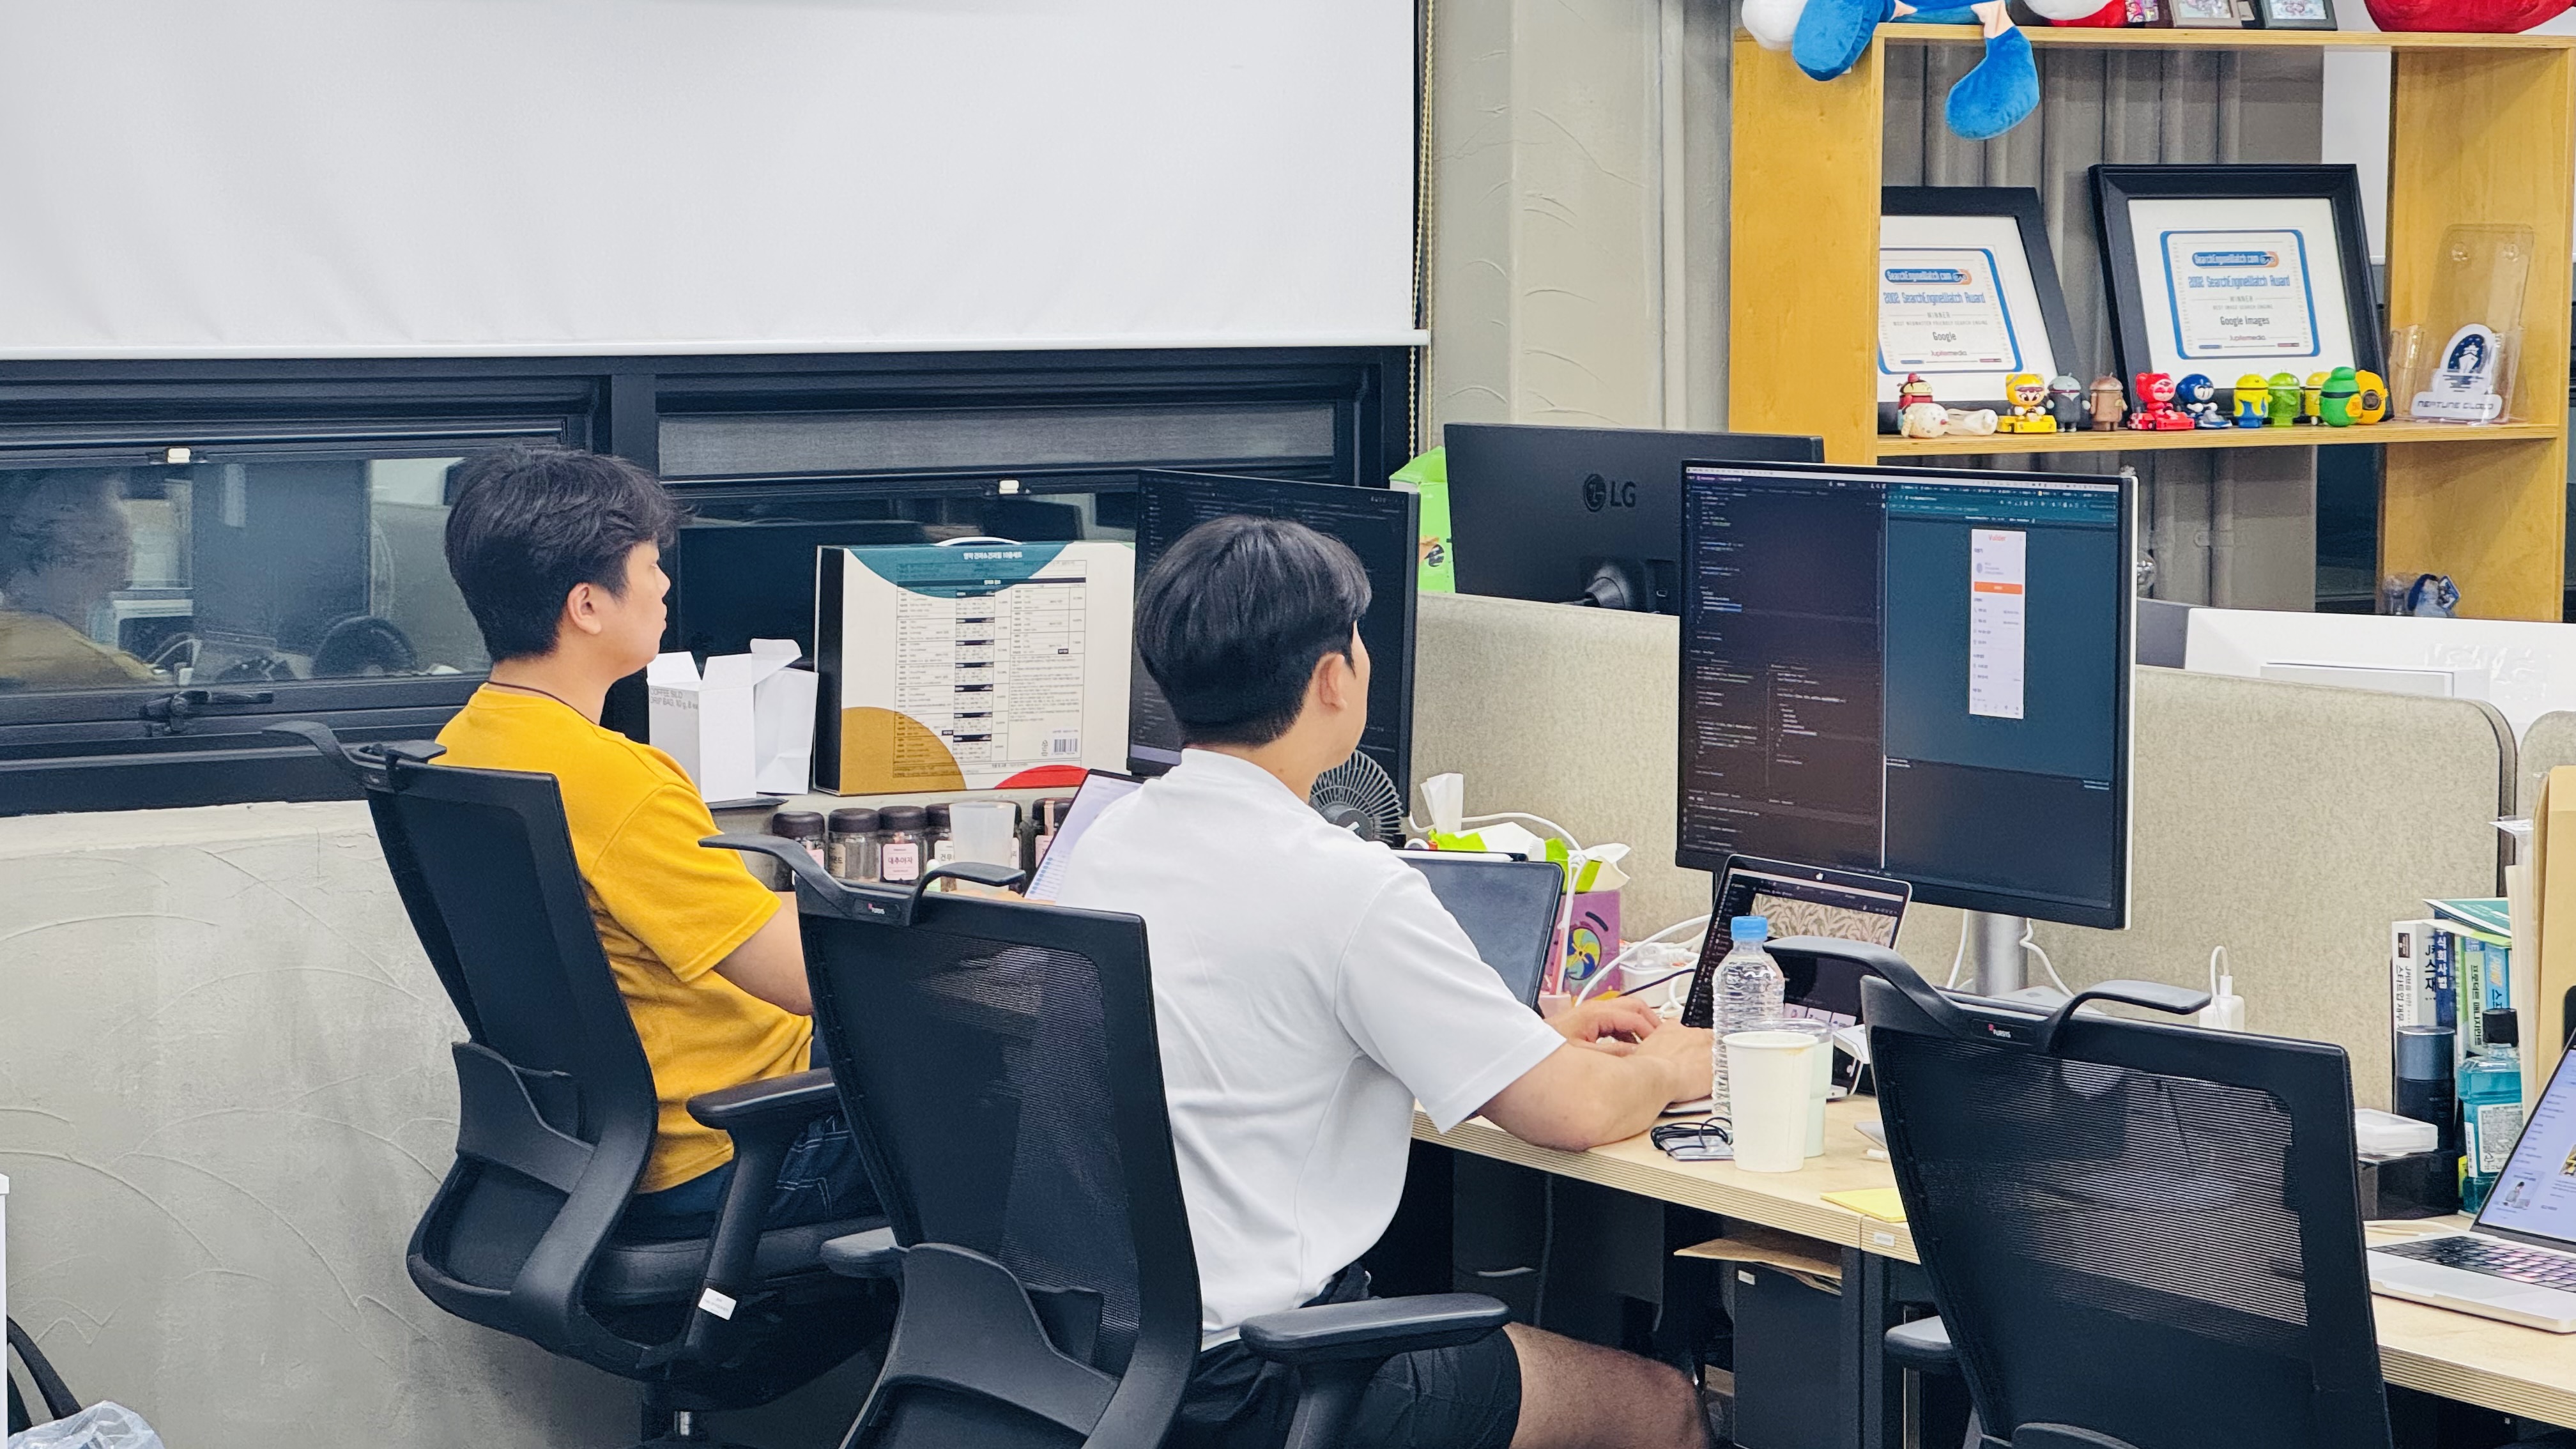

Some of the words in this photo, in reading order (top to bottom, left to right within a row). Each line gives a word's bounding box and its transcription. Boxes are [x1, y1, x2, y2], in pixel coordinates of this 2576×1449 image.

[2220, 316, 2243, 327] Google
[2245, 316, 2270, 326] Images
[1933, 332, 1957, 342] Google
[2418, 401, 2460, 409] NEPTUNE
[1610, 480, 1636, 508] LG
[650, 687, 670, 698] COFFEE
[887, 856, 913, 864] 대추야자
[940, 853, 955, 862] 건무
[2396, 965, 2404, 1001] 스타트업
[2471, 965, 2480, 999] 프로덕트
[2396, 1003, 2404, 1022] 재무
[2472, 1002, 2482, 1046] 매니지먼트
